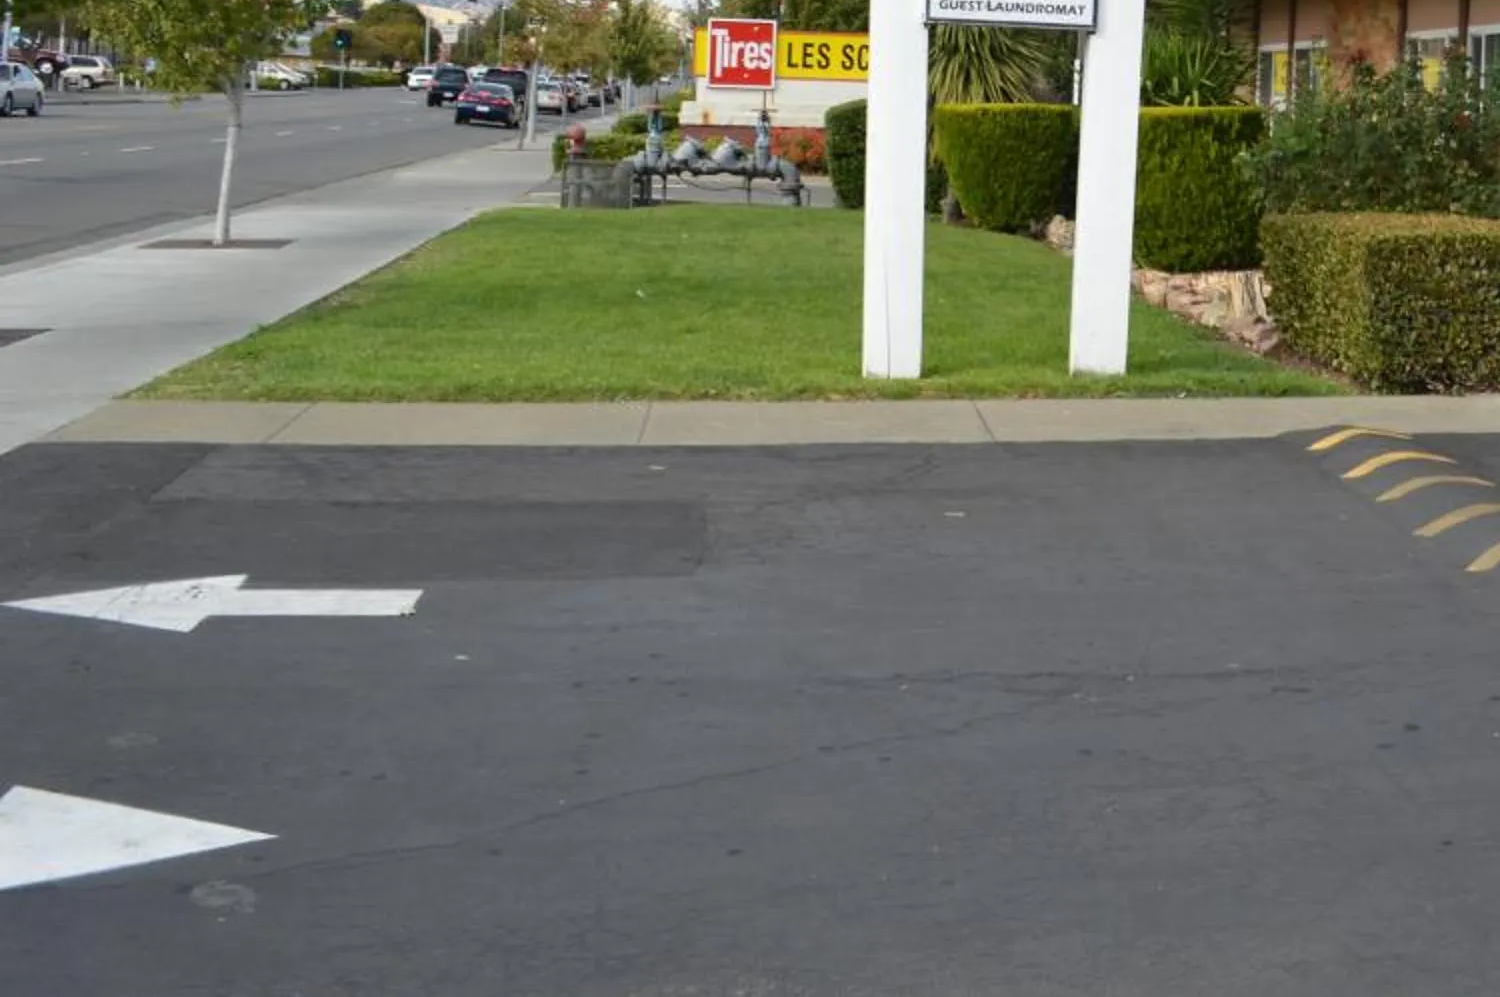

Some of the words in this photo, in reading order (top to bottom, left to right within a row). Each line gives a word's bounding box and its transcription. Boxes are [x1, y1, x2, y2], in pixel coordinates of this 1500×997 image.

[986, 0, 1087, 16] LAUNDROMAT
[711, 28, 773, 78] Tires
[786, 42, 831, 70] LES
